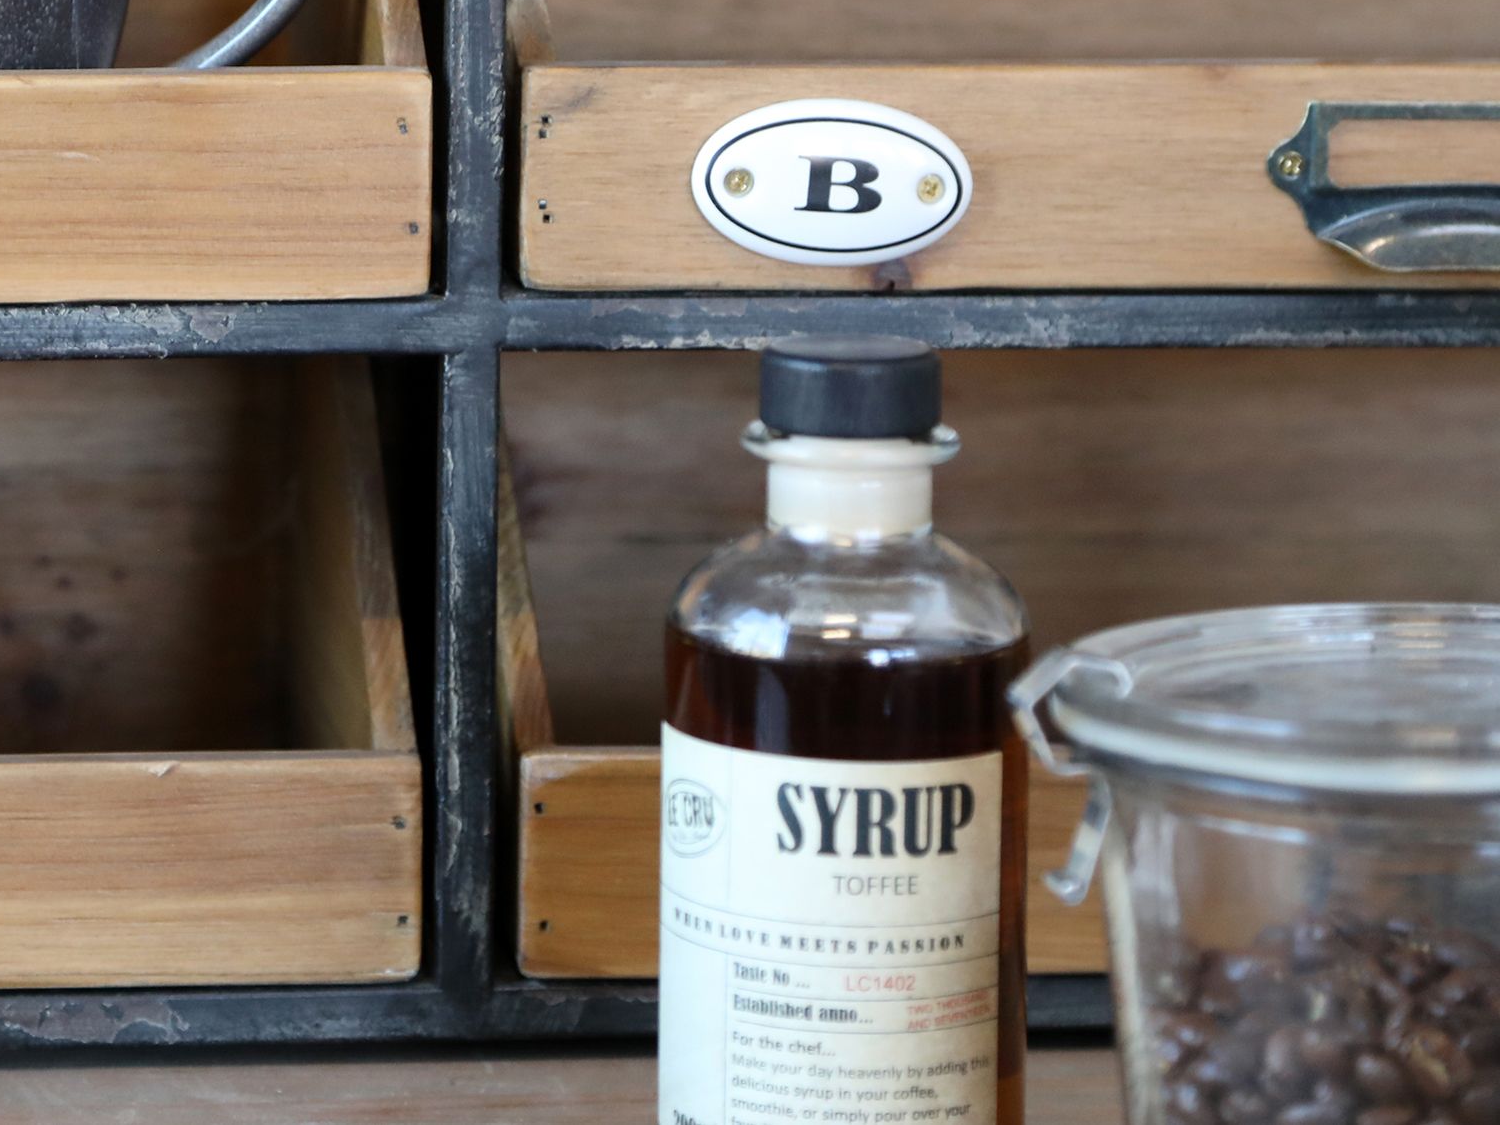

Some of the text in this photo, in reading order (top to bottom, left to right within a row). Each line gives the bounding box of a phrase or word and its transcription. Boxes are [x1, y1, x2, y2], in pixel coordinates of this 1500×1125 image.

[794, 155, 882, 214] B
[776, 781, 975, 859] SYRUP
[832, 875, 919, 897] TOFFEE
[719, 924, 771, 948] LOVE
[779, 935, 857, 955] MEETS
[868, 933, 965, 956] PASSION
[844, 975, 917, 993] LC1402
[733, 993, 813, 1022] Established
[732, 1031, 755, 1047] For
[759, 1035, 783, 1051] the
[732, 1052, 766, 1069] Make
[771, 1063, 803, 1076] your
[808, 1064, 832, 1080] day
[838, 1066, 904, 1082] heavenly
[907, 1066, 924, 1078] by
[927, 1060, 970, 1077] adding
[731, 1075, 940, 1103] delicious syrup in your coffee,
[731, 1097, 798, 1120] smoothie,
[802, 1107, 818, 1121] or
[822, 1107, 870, 1124] simply
[874, 1109, 908, 1124] pour
[912, 1108, 941, 1122] over
[945, 1103, 973, 1120] your
